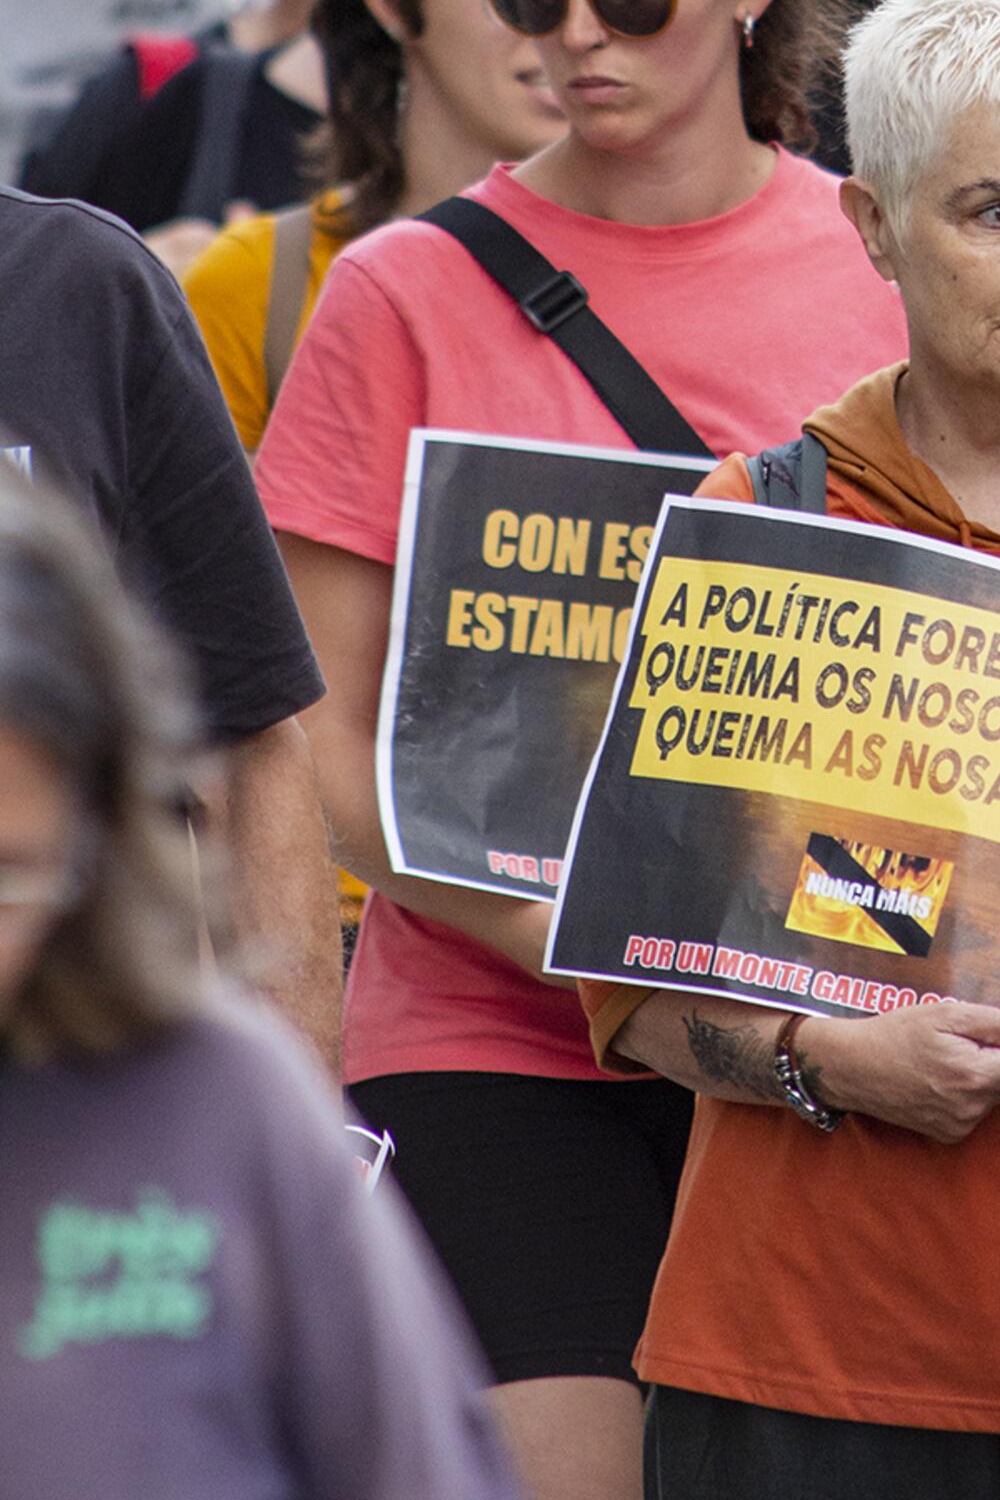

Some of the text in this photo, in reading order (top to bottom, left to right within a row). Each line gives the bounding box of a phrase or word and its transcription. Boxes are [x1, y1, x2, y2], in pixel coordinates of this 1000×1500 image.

[482, 509, 591, 577] CON
[660, 583, 689, 628] A
[698, 583, 882, 653] POLÍTICA
[645, 642, 800, 703] QUEIMA
[815, 662, 876, 714] OS
[655, 705, 812, 770] QUEIMA
[823, 729, 887, 781] AS
[487, 851, 540, 882] POR
[804, 871, 876, 909] NUNCA
[623, 935, 676, 970] POR
[675, 942, 714, 975] UN
[711, 947, 813, 996] MONTE
[810, 971, 917, 1016] GALEGO
